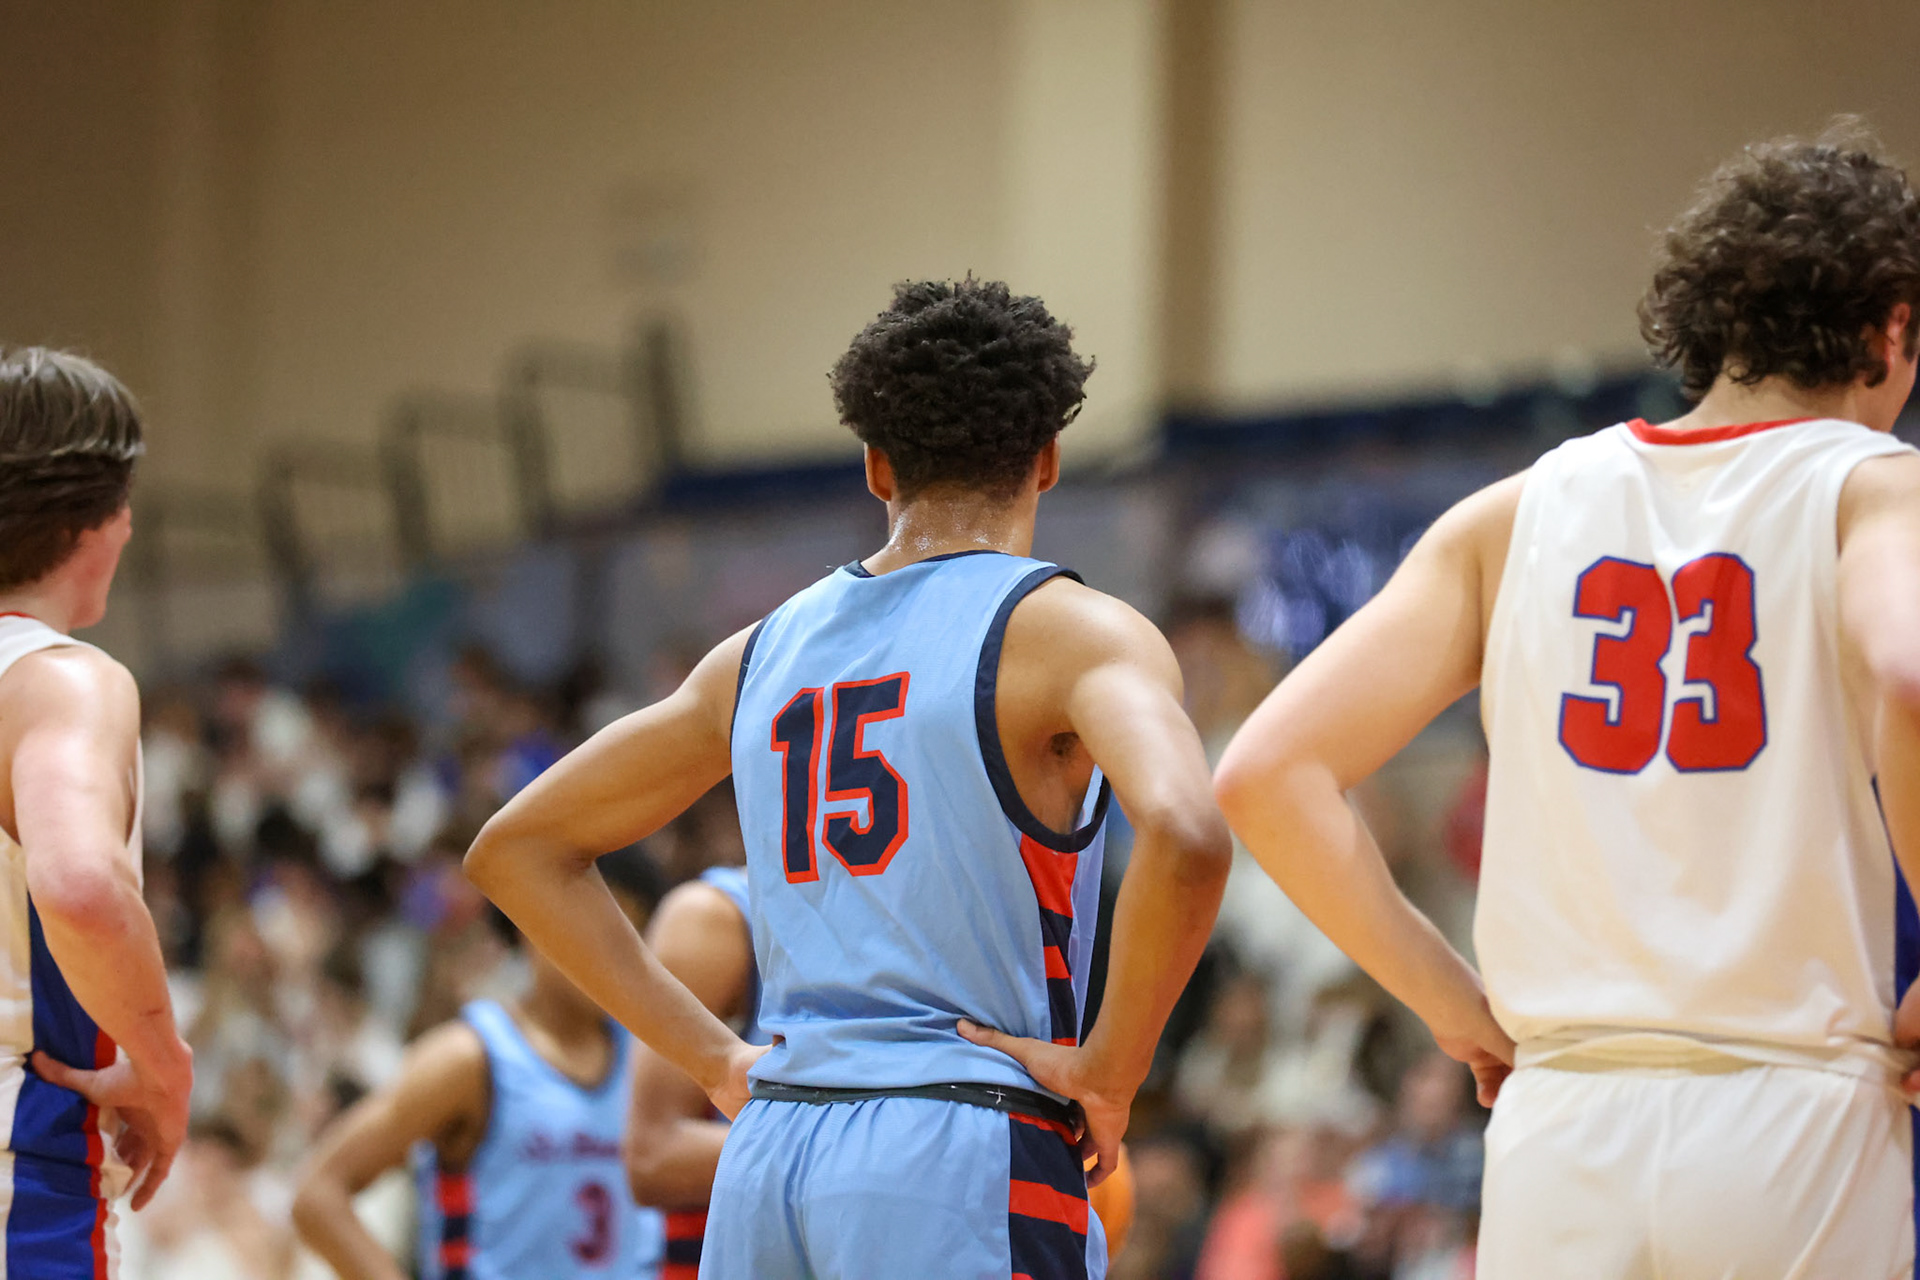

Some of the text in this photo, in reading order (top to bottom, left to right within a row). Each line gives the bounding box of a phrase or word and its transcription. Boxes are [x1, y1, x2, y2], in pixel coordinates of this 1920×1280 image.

[1558, 552, 1768, 775] 33
[770, 671, 909, 884] 15
[570, 1179, 618, 1268] 3
